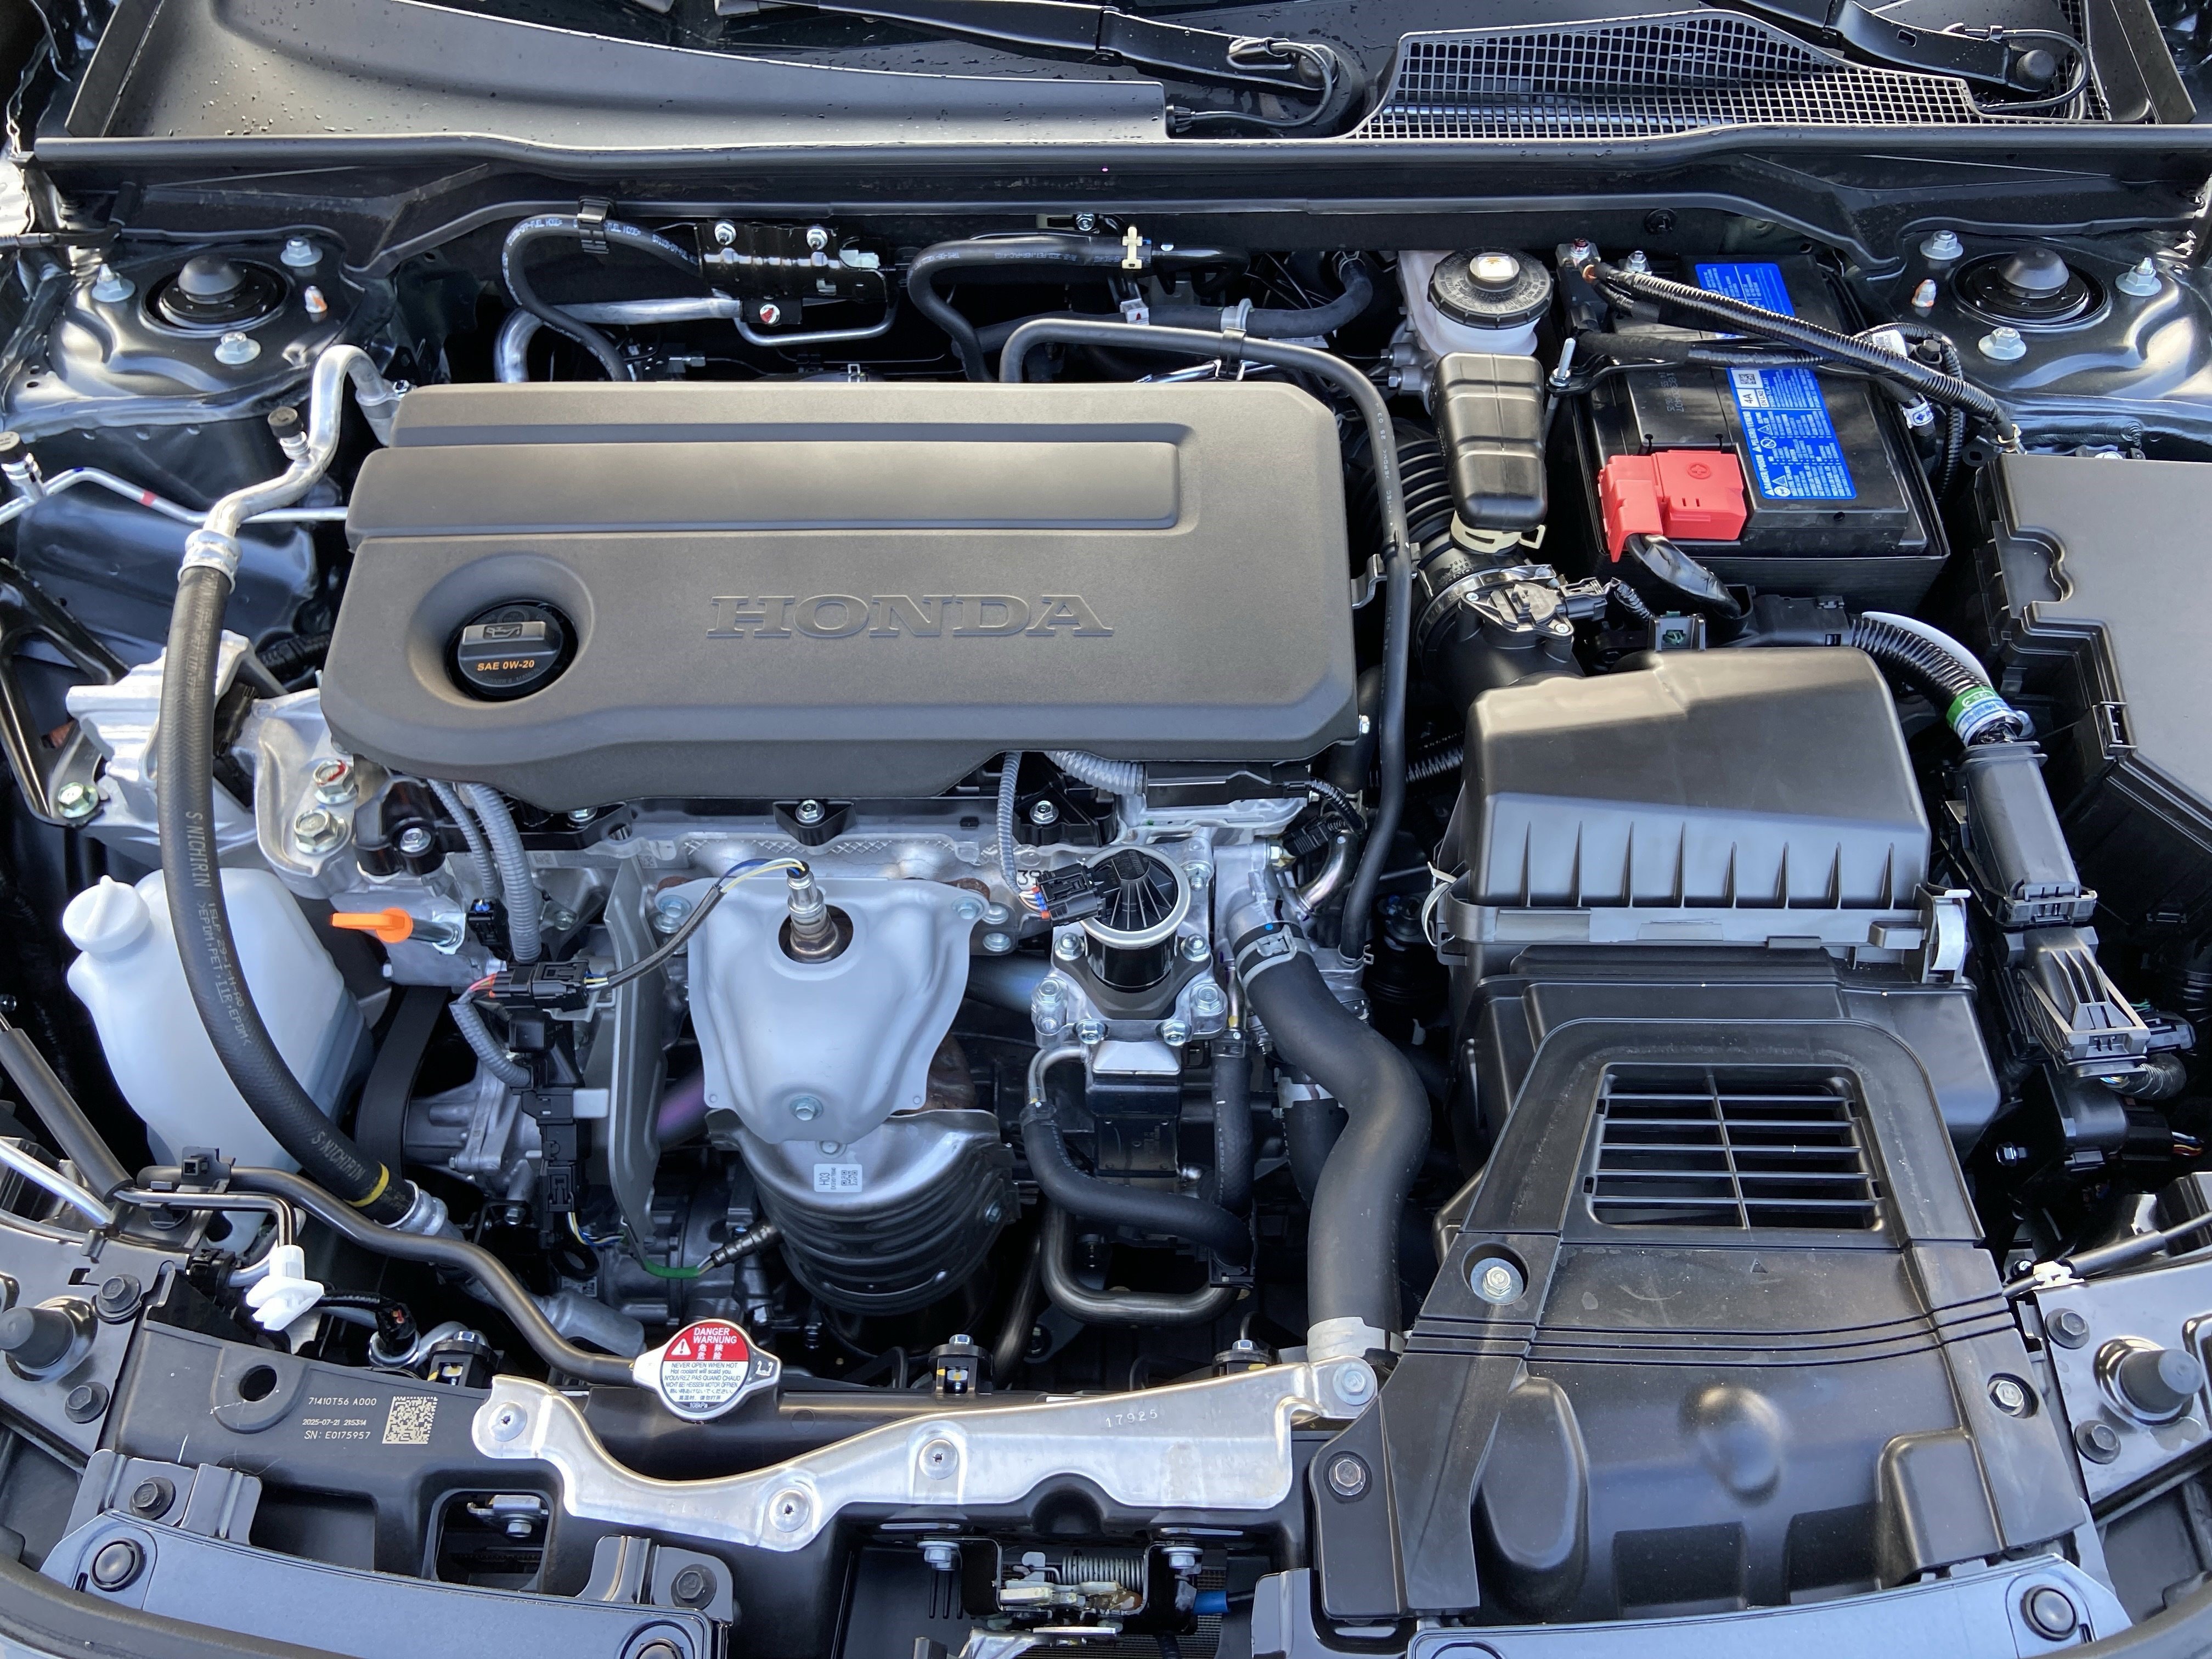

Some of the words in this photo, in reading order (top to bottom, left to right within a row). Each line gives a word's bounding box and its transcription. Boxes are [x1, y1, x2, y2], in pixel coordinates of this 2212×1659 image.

[1742, 393, 1754, 404] 4A
[707, 594, 1114, 638] HONDA
[477, 662, 499, 672] SAE
[503, 660, 535, 669] 0W-20
[819, 1172, 830, 1186] H03
[694, 1327, 730, 1336] DANGER
[693, 1335, 737, 1344] WARNUNG
[308, 1397, 349, 1406] 71410T56
[353, 1397, 377, 1406] A000
[302, 1418, 340, 1426] 2025-07-21
[1105, 1409, 1158, 1428] 17925
[304, 1430, 322, 1440] SN:
[325, 1430, 371, 1440] E0175957
